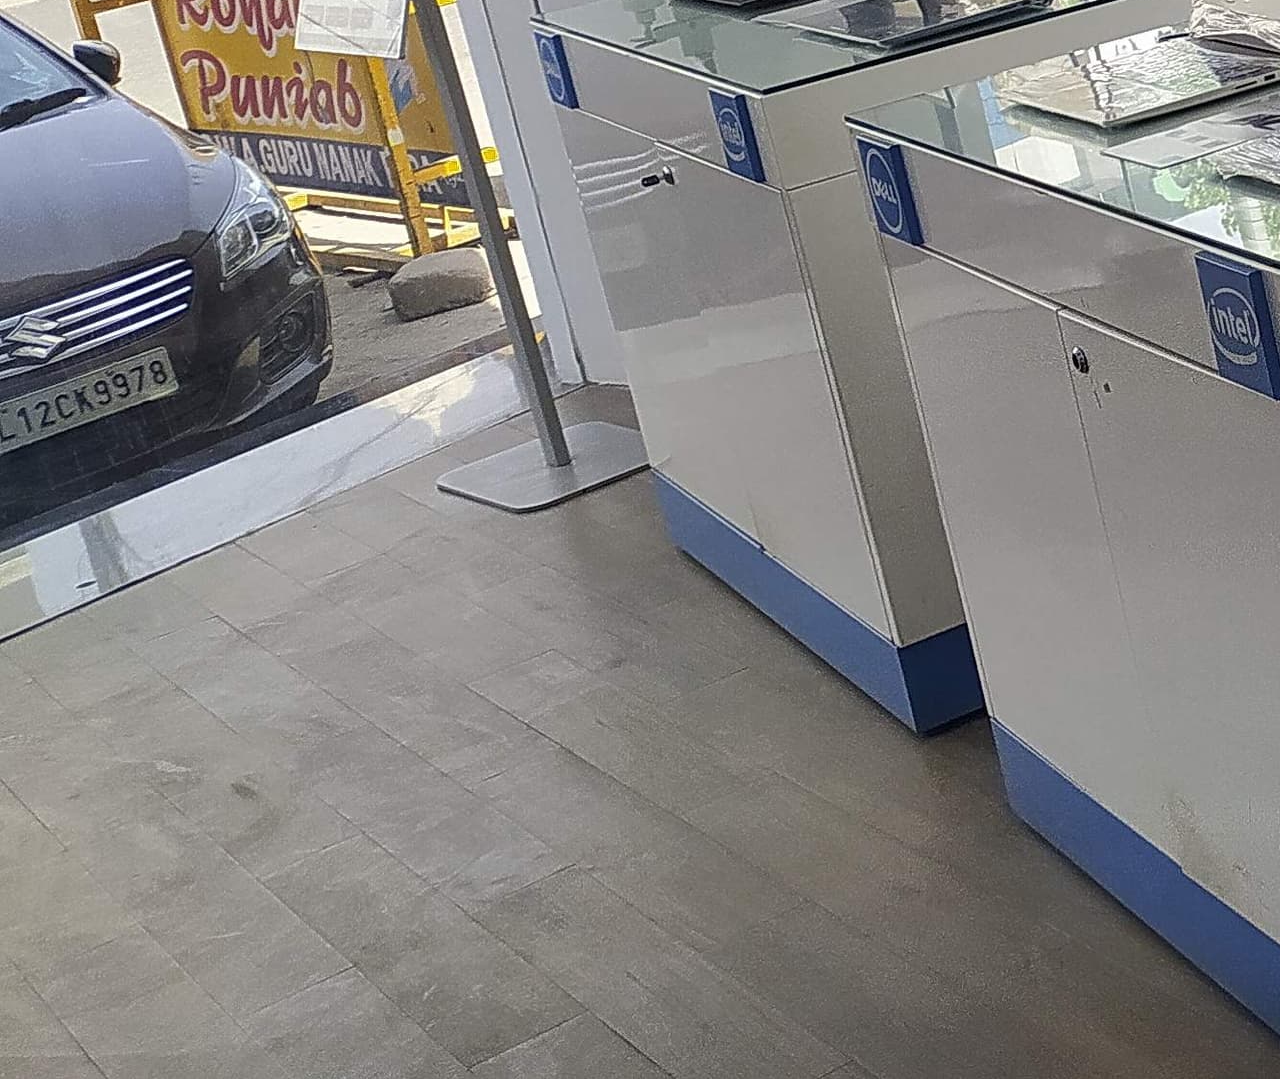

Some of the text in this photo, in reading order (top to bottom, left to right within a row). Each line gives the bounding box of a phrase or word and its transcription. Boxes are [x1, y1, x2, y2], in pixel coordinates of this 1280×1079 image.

[180, 49, 363, 129] Punjab
[317, 143, 384, 187] NANAK
[871, 175, 897, 205] DELL
[1210, 301, 1256, 349] intel
